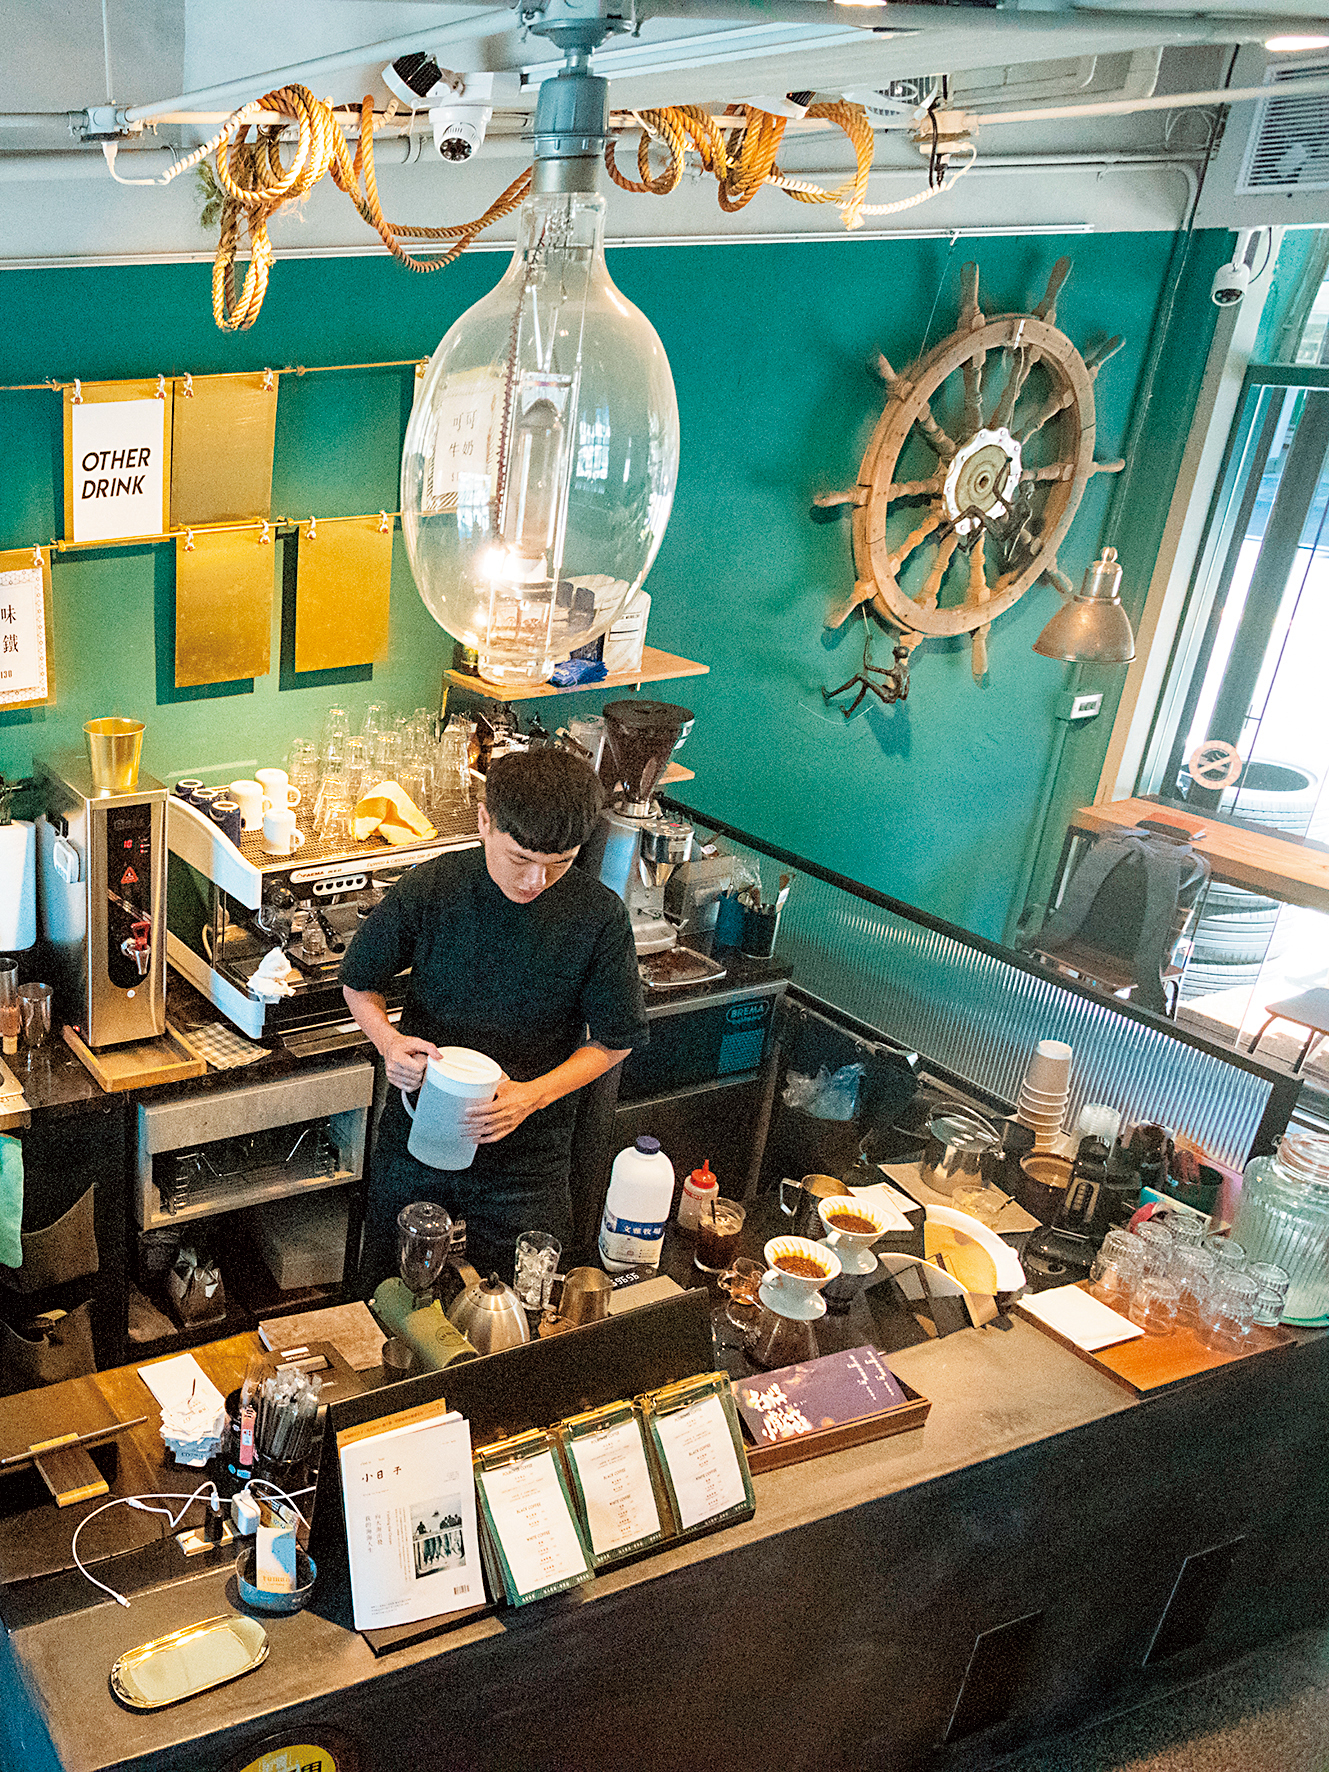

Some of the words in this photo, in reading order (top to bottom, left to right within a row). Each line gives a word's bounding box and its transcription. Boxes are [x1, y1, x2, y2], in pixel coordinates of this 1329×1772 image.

[81, 447, 151, 472] OTHER
[81, 474, 146, 500] DRINK
[730, 1004, 764, 1018] BREMA
